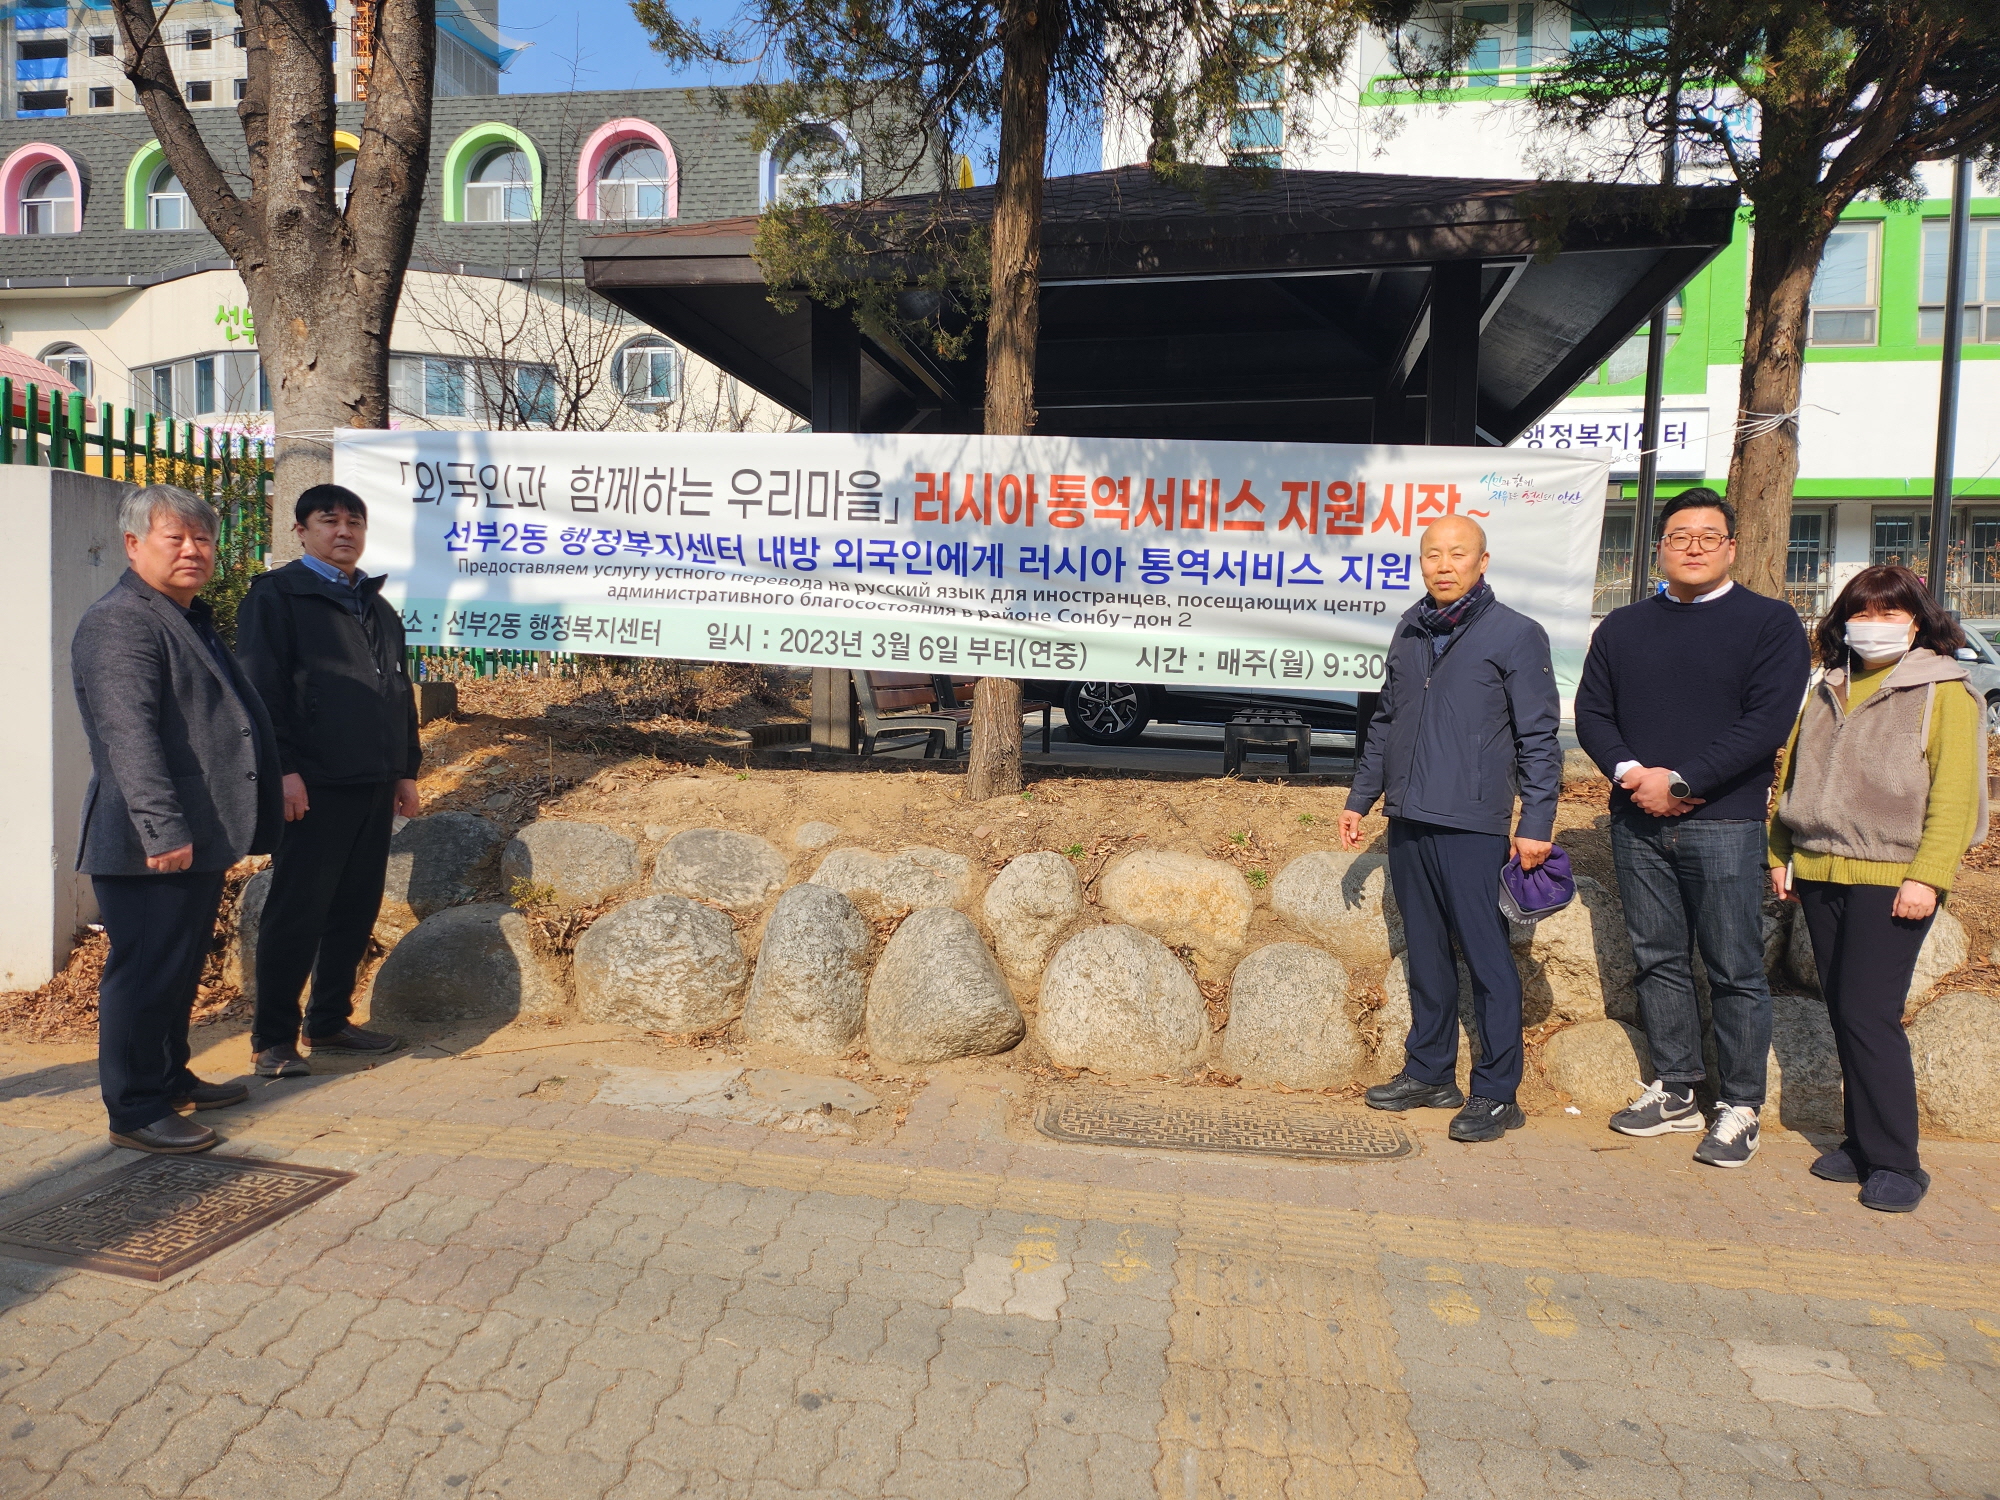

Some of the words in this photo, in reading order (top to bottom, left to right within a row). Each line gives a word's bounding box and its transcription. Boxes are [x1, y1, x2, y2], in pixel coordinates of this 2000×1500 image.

[570, 464, 714, 516] 함께하는
[727, 468, 899, 525] 우리마을」
[1557, 490, 1584, 505] 안산
[443, 520, 548, 555] 선부2동
[559, 527, 747, 567] 행정복지센터
[758, 536, 822, 572] 내방
[832, 538, 1004, 576] 외국인에게
[1019, 544, 1127, 583] 러시아
[1137, 547, 1325, 588] 통역서비스
[1338, 552, 1412, 590] 지원
[458, 558, 588, 576] Предоставляем
[593, 563, 650, 581] услугу
[655, 566, 726, 581] устного
[730, 573, 823, 591] перевода
[828, 580, 850, 593] на
[855, 582, 930, 598] русский
[936, 587, 986, 600] язык
[990, 588, 1027, 604] для
[1033, 589, 1172, 608] иностранцев,
[1177, 595, 1317, 613] посещающих
[1324, 599, 1387, 615] центр
[607, 585, 794, 605] административного
[800, 591, 956, 617] благосостояния
[961, 609, 973, 618] в
[978, 606, 1052, 622] районе
[1057, 608, 1172, 629] Сонбу-дон
[1178, 612, 1193, 627] 2
[397, 609, 423, 633] 소
[446, 610, 522, 639] 선부2동
[529, 613, 662, 646] 행정복지센터
[706, 622, 752, 651] 일시
[779, 627, 862, 657] 2023년
[872, 632, 911, 661] 3월
[919, 636, 958, 664] 6일
[967, 637, 1088, 671] 부터(연중)
[1135, 645, 1188, 673] 시간
[1217, 648, 1315, 680] 매주(월)
[1322, 652, 1387, 680] 9:30
